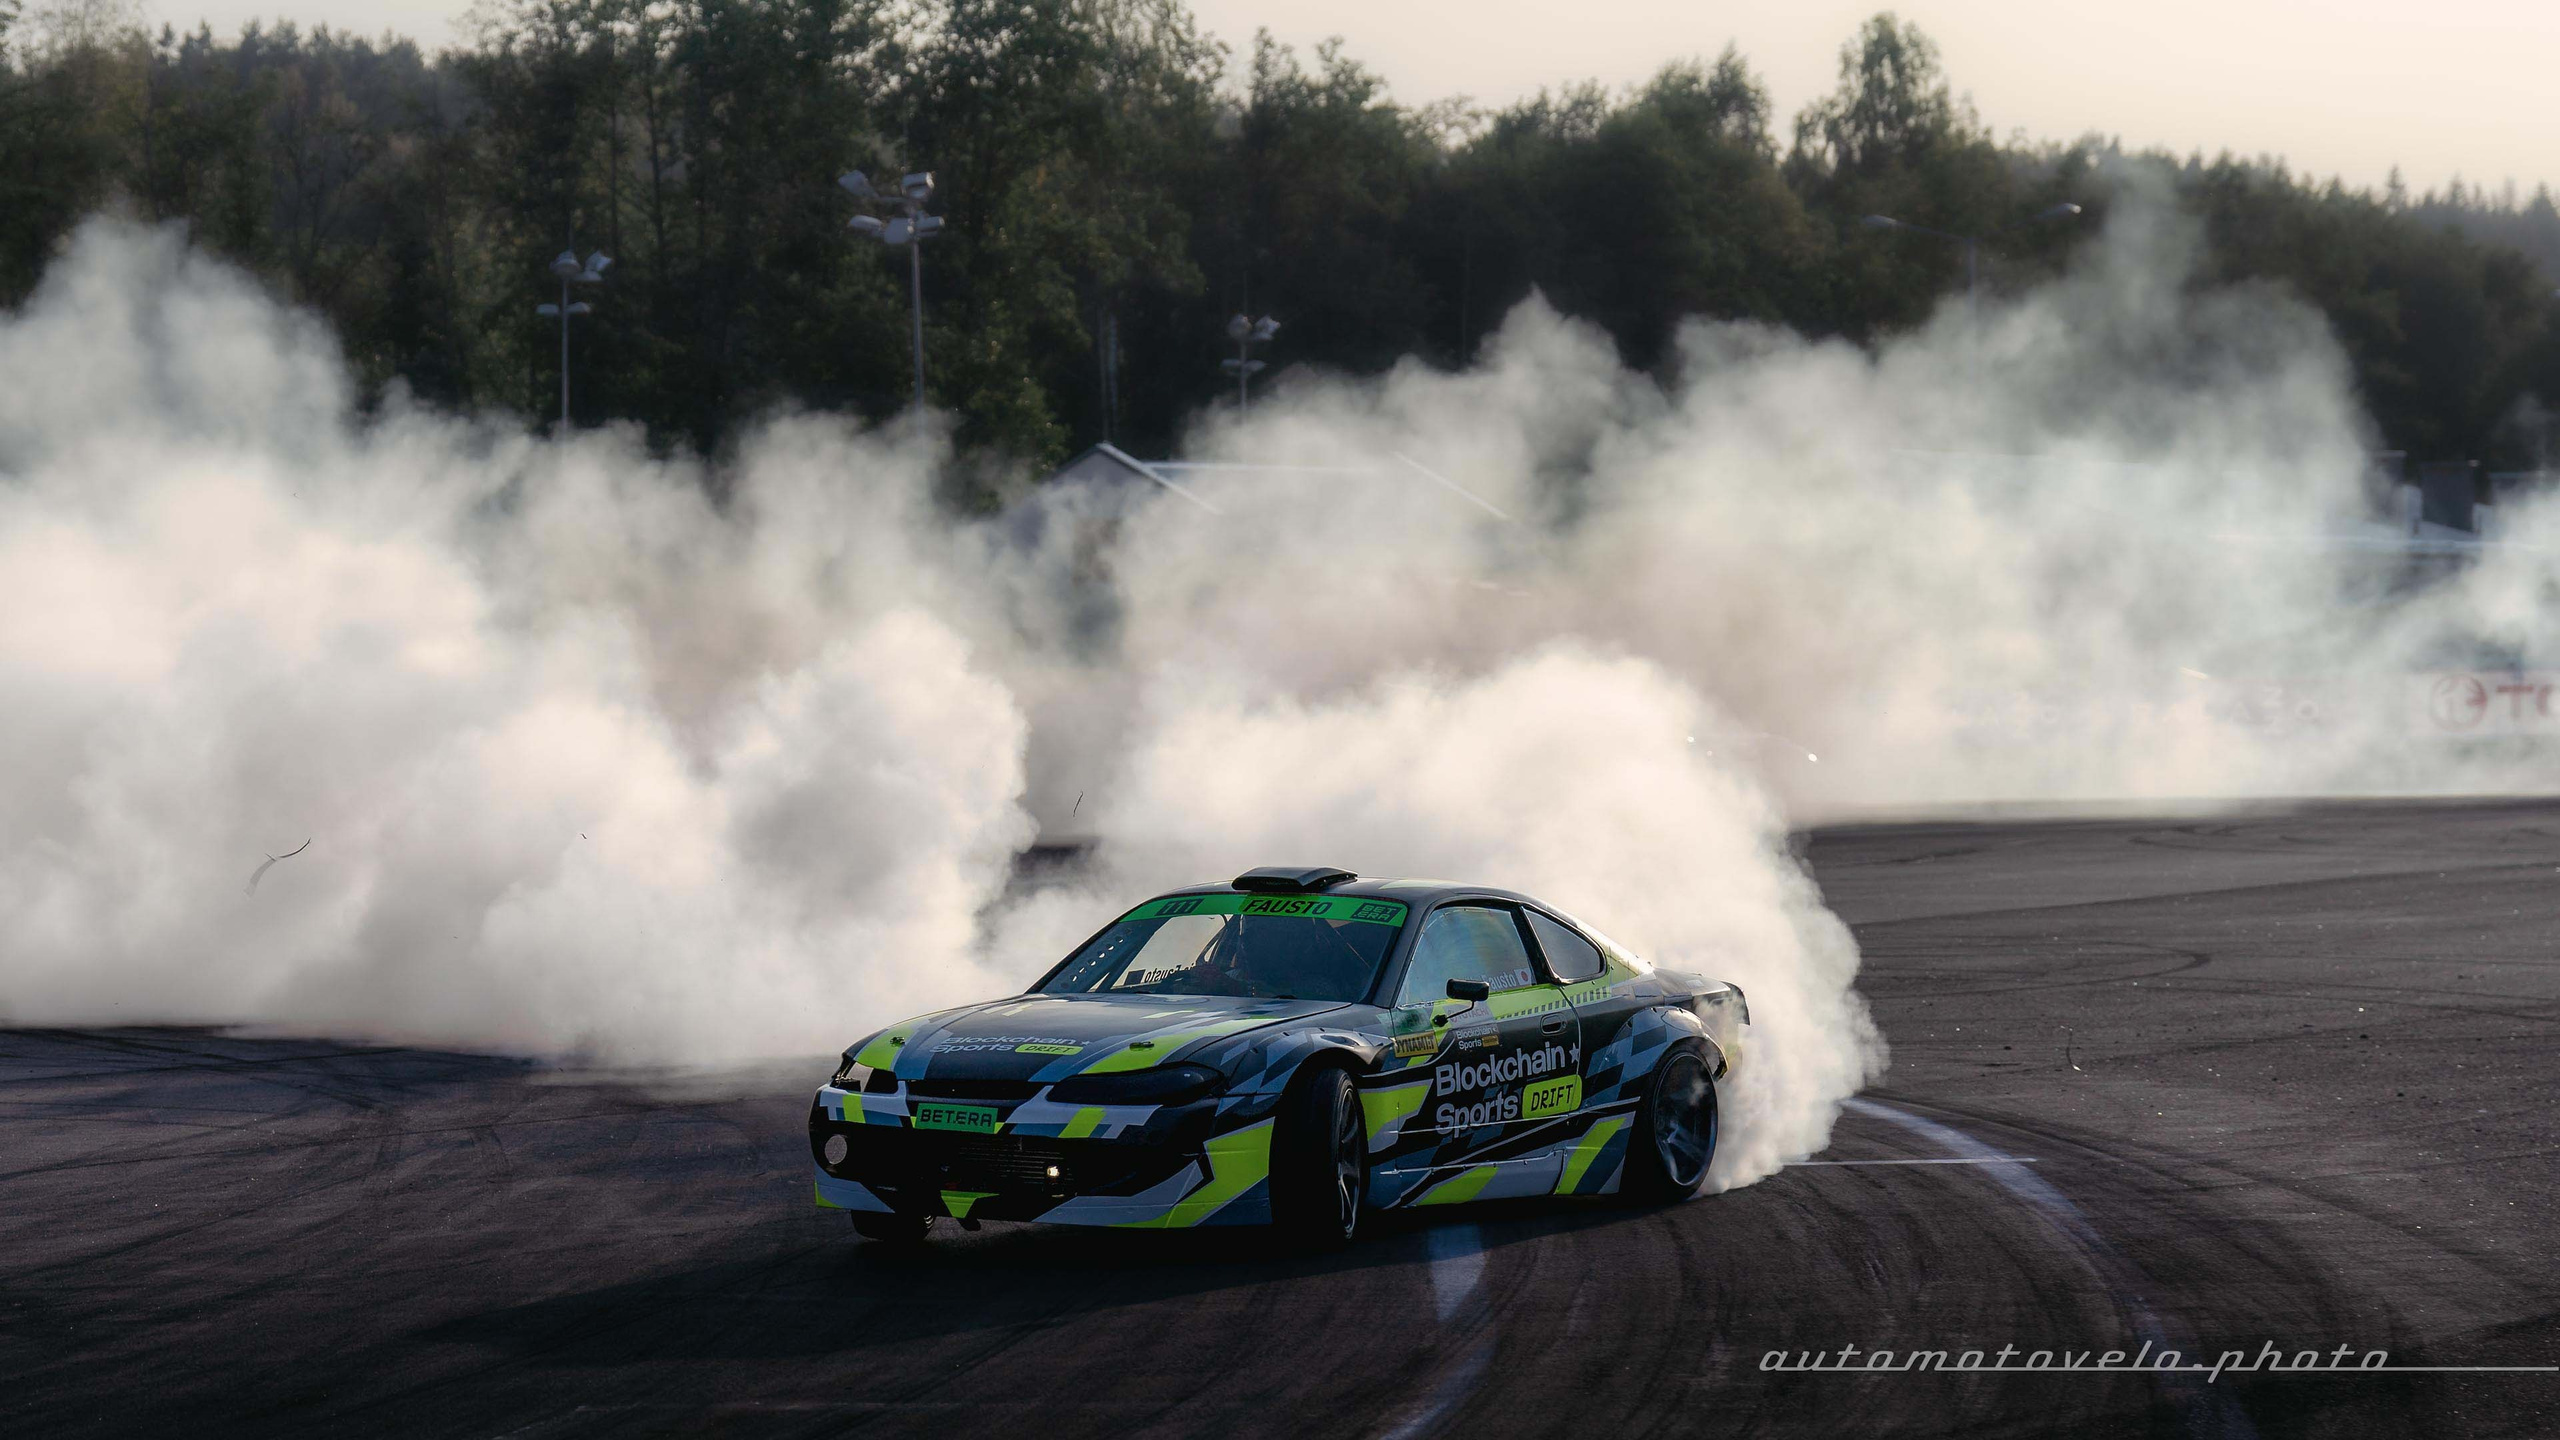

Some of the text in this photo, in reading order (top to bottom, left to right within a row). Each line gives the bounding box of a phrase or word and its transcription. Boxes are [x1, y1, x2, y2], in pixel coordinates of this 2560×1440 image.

[1243, 900, 1333, 915] FAUSTO
[1456, 1025, 1493, 1040] Blockchain
[931, 1043, 1075, 1053] Sports DRIFT
[943, 1036, 1076, 1045] Blockchain
[1459, 1038, 1482, 1051] Sports
[1436, 1042, 1566, 1097] Blockchain
[1435, 1084, 1573, 1138] Sports DRIFT
